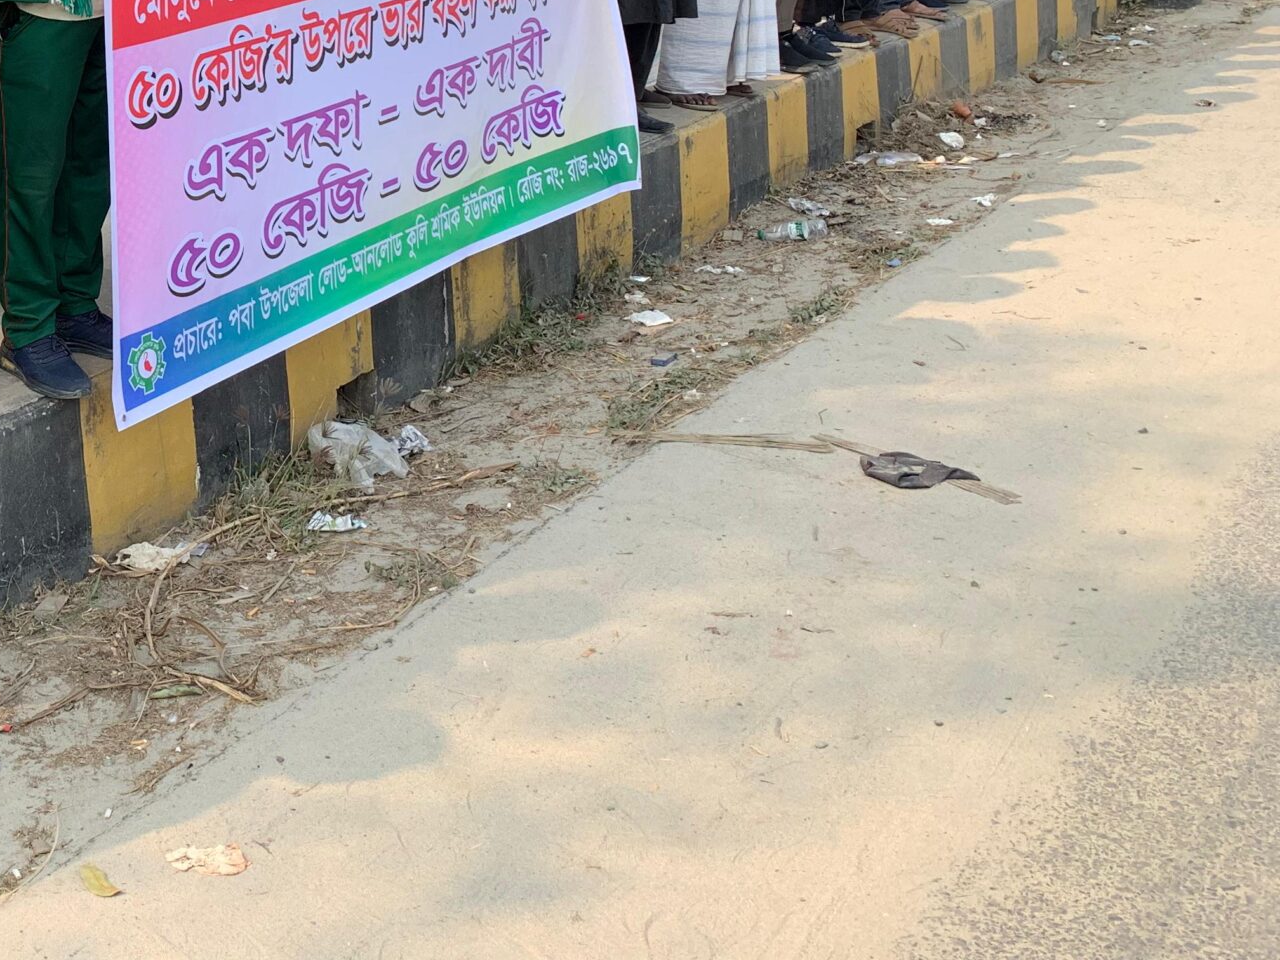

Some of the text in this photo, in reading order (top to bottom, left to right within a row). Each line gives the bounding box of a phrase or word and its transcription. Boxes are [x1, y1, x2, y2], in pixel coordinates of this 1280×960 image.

[128, 69, 179, 122] ৫০
[298, 7, 374, 64] উপরে
[187, 126, 273, 193] এক
[280, 88, 369, 162] দফা
[415, 55, 480, 113] এক
[484, 16, 550, 87] দাবী
[170, 232, 241, 291] ৫০
[263, 162, 371, 251] কেজি
[415, 139, 468, 187] ৫০
[482, 84, 563, 156] কেজি
[228, 298, 256, 335] পবা
[258, 269, 314, 320] উপজেলা
[318, 230, 404, 295] লোড-আনলোড
[405, 214, 429, 259] কুলি
[431, 203, 461, 242] শ্রমিক
[517, 166, 544, 204] রেজি
